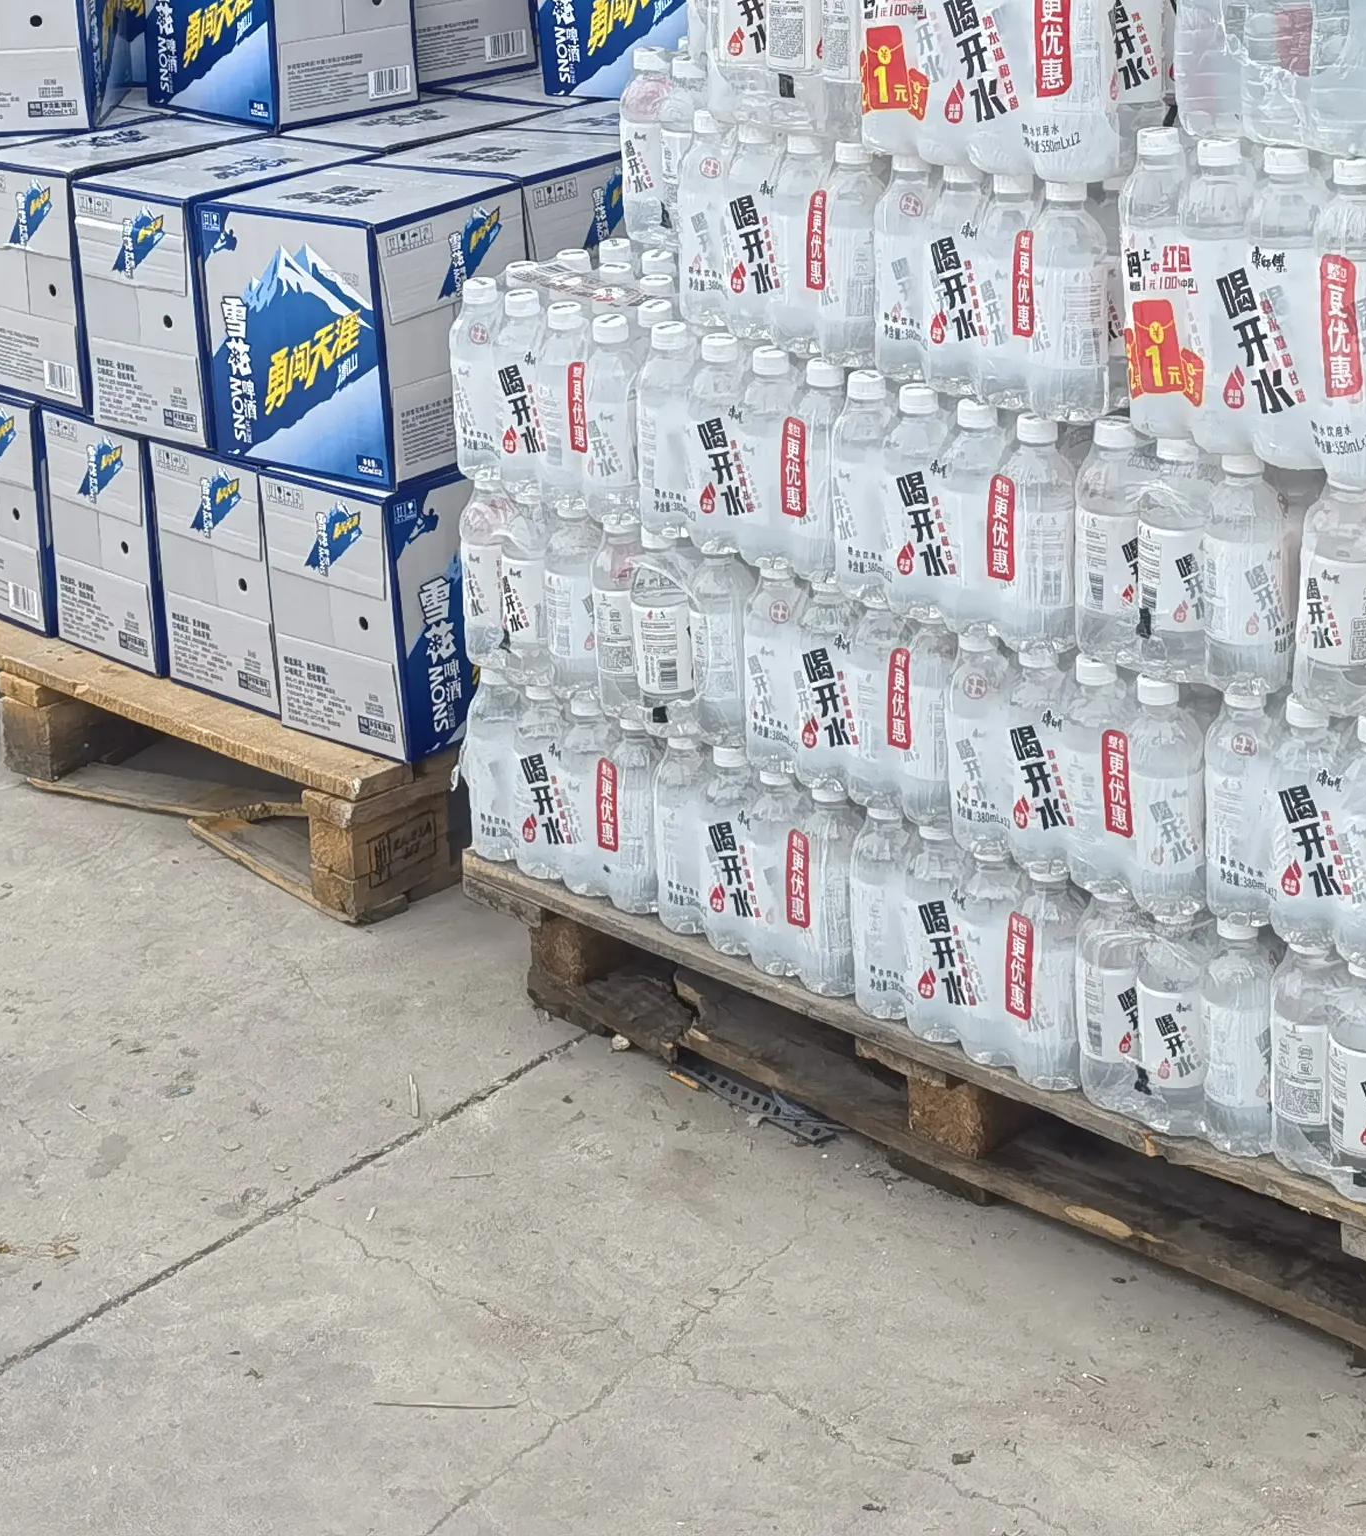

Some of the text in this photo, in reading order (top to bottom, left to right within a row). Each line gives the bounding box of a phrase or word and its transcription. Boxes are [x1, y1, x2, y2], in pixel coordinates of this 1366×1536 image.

[157, 37, 170, 93] SNOW
[555, 26, 572, 83] SNOW
[728, 194, 775, 295] 喝开水
[809, 212, 824, 286] 更优惠
[929, 236, 978, 343] 喝开水
[1015, 251, 1033, 332] 更优惠
[222, 295, 252, 377] 雪花
[265, 309, 361, 415] 勇闯天涯
[1145, 345, 1182, 387] 1元
[1216, 267, 1296, 414] 喝开水
[1327, 284, 1353, 389] 更优惠
[229, 376, 247, 442] SNOW
[498, 364, 541, 454] 喝开水
[696, 417, 740, 516] 喝开水
[784, 439, 803, 511] 更优惠
[896, 471, 948, 576] 喝开水
[992, 496, 1010, 575] 更优惠
[418, 577, 455, 663] 雪花
[1306, 576, 1333, 649] 喝开水
[428, 666, 450, 734] SNOW
[802, 648, 850, 748] 喝开水
[891, 667, 908, 746] 更优惠
[520, 753, 567, 847] 喝开水
[600, 777, 615, 850] 更优惠
[1009, 724, 1068, 831] 喝开水
[1108, 751, 1129, 831] 更优惠
[708, 821, 754, 919] 喝开水
[1278, 784, 1342, 898] 喝开水
[789, 853, 807, 922] 更优惠
[918, 899, 969, 1006] 喝开水
[1009, 935, 1031, 1017] 更优惠
[1155, 1013, 1197, 1078] 喝开水
